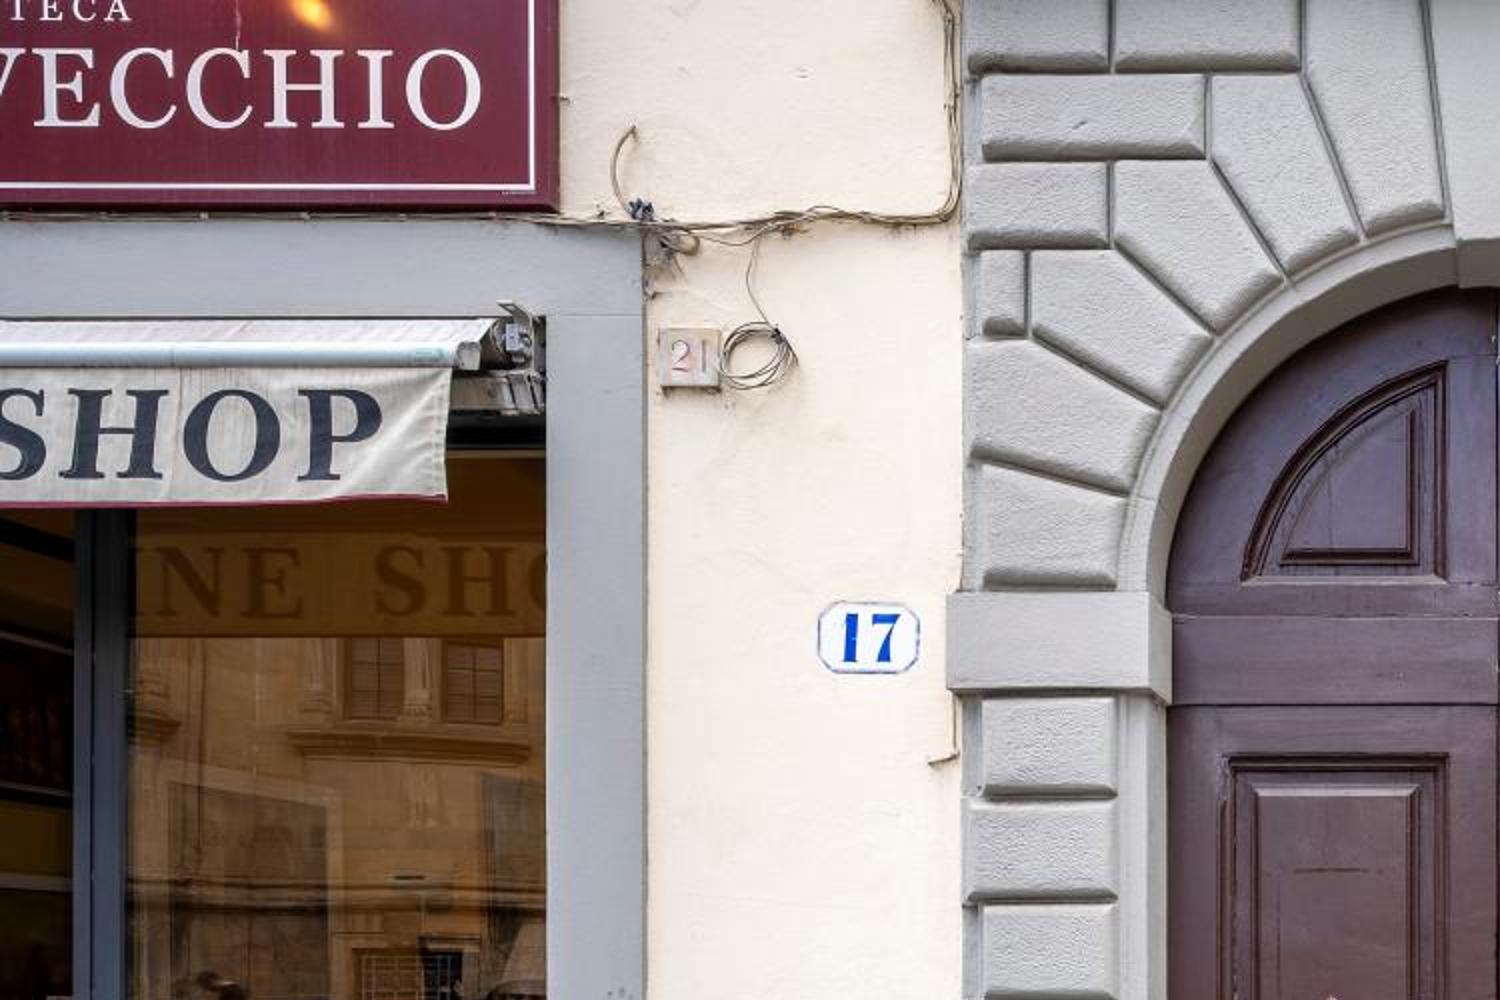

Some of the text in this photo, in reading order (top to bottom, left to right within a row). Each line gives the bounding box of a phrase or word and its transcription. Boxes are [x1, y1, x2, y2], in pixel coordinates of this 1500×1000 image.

[0, 388, 382, 482] SHOP
[137, 545, 546, 619] NE SH
[842, 612, 902, 663] 17
